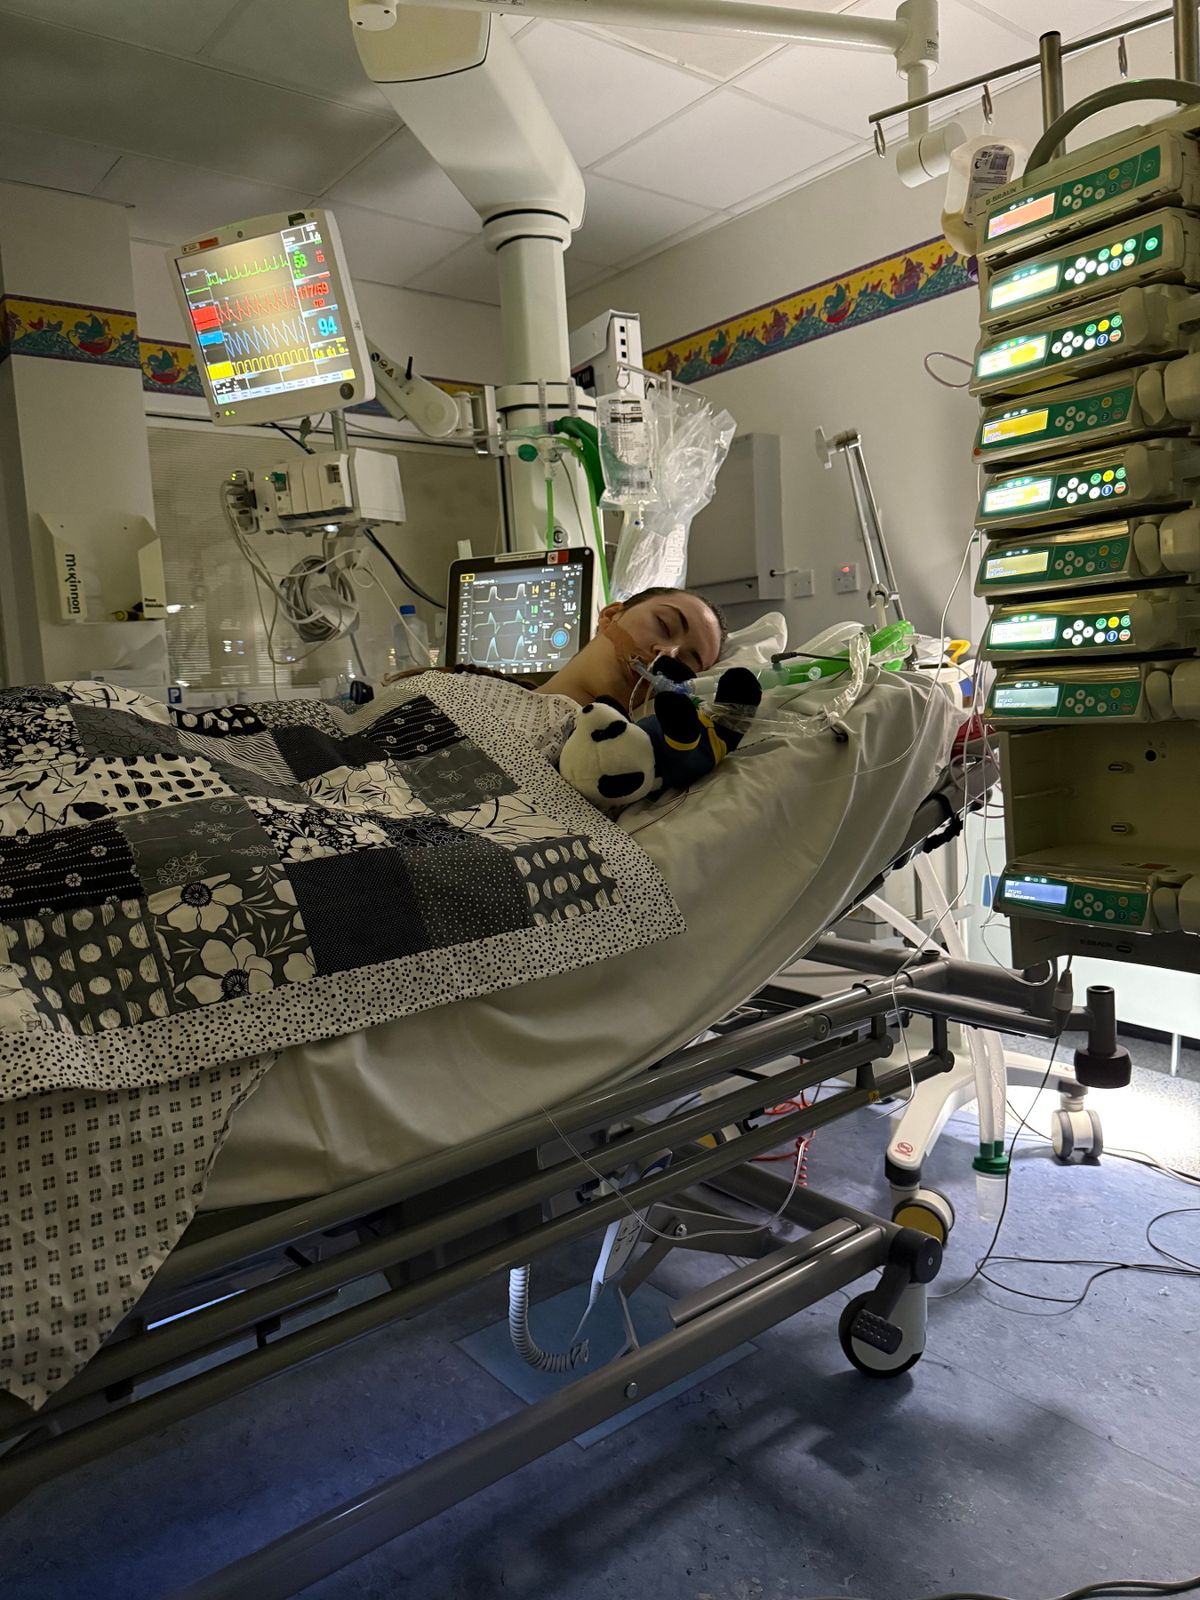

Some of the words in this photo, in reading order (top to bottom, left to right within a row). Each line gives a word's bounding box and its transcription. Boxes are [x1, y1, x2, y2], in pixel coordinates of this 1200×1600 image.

[293, 253, 308, 268] 58
[297, 281, 330, 300] 117/59
[318, 315, 338, 337] 94
[169, 688, 180, 703] P
